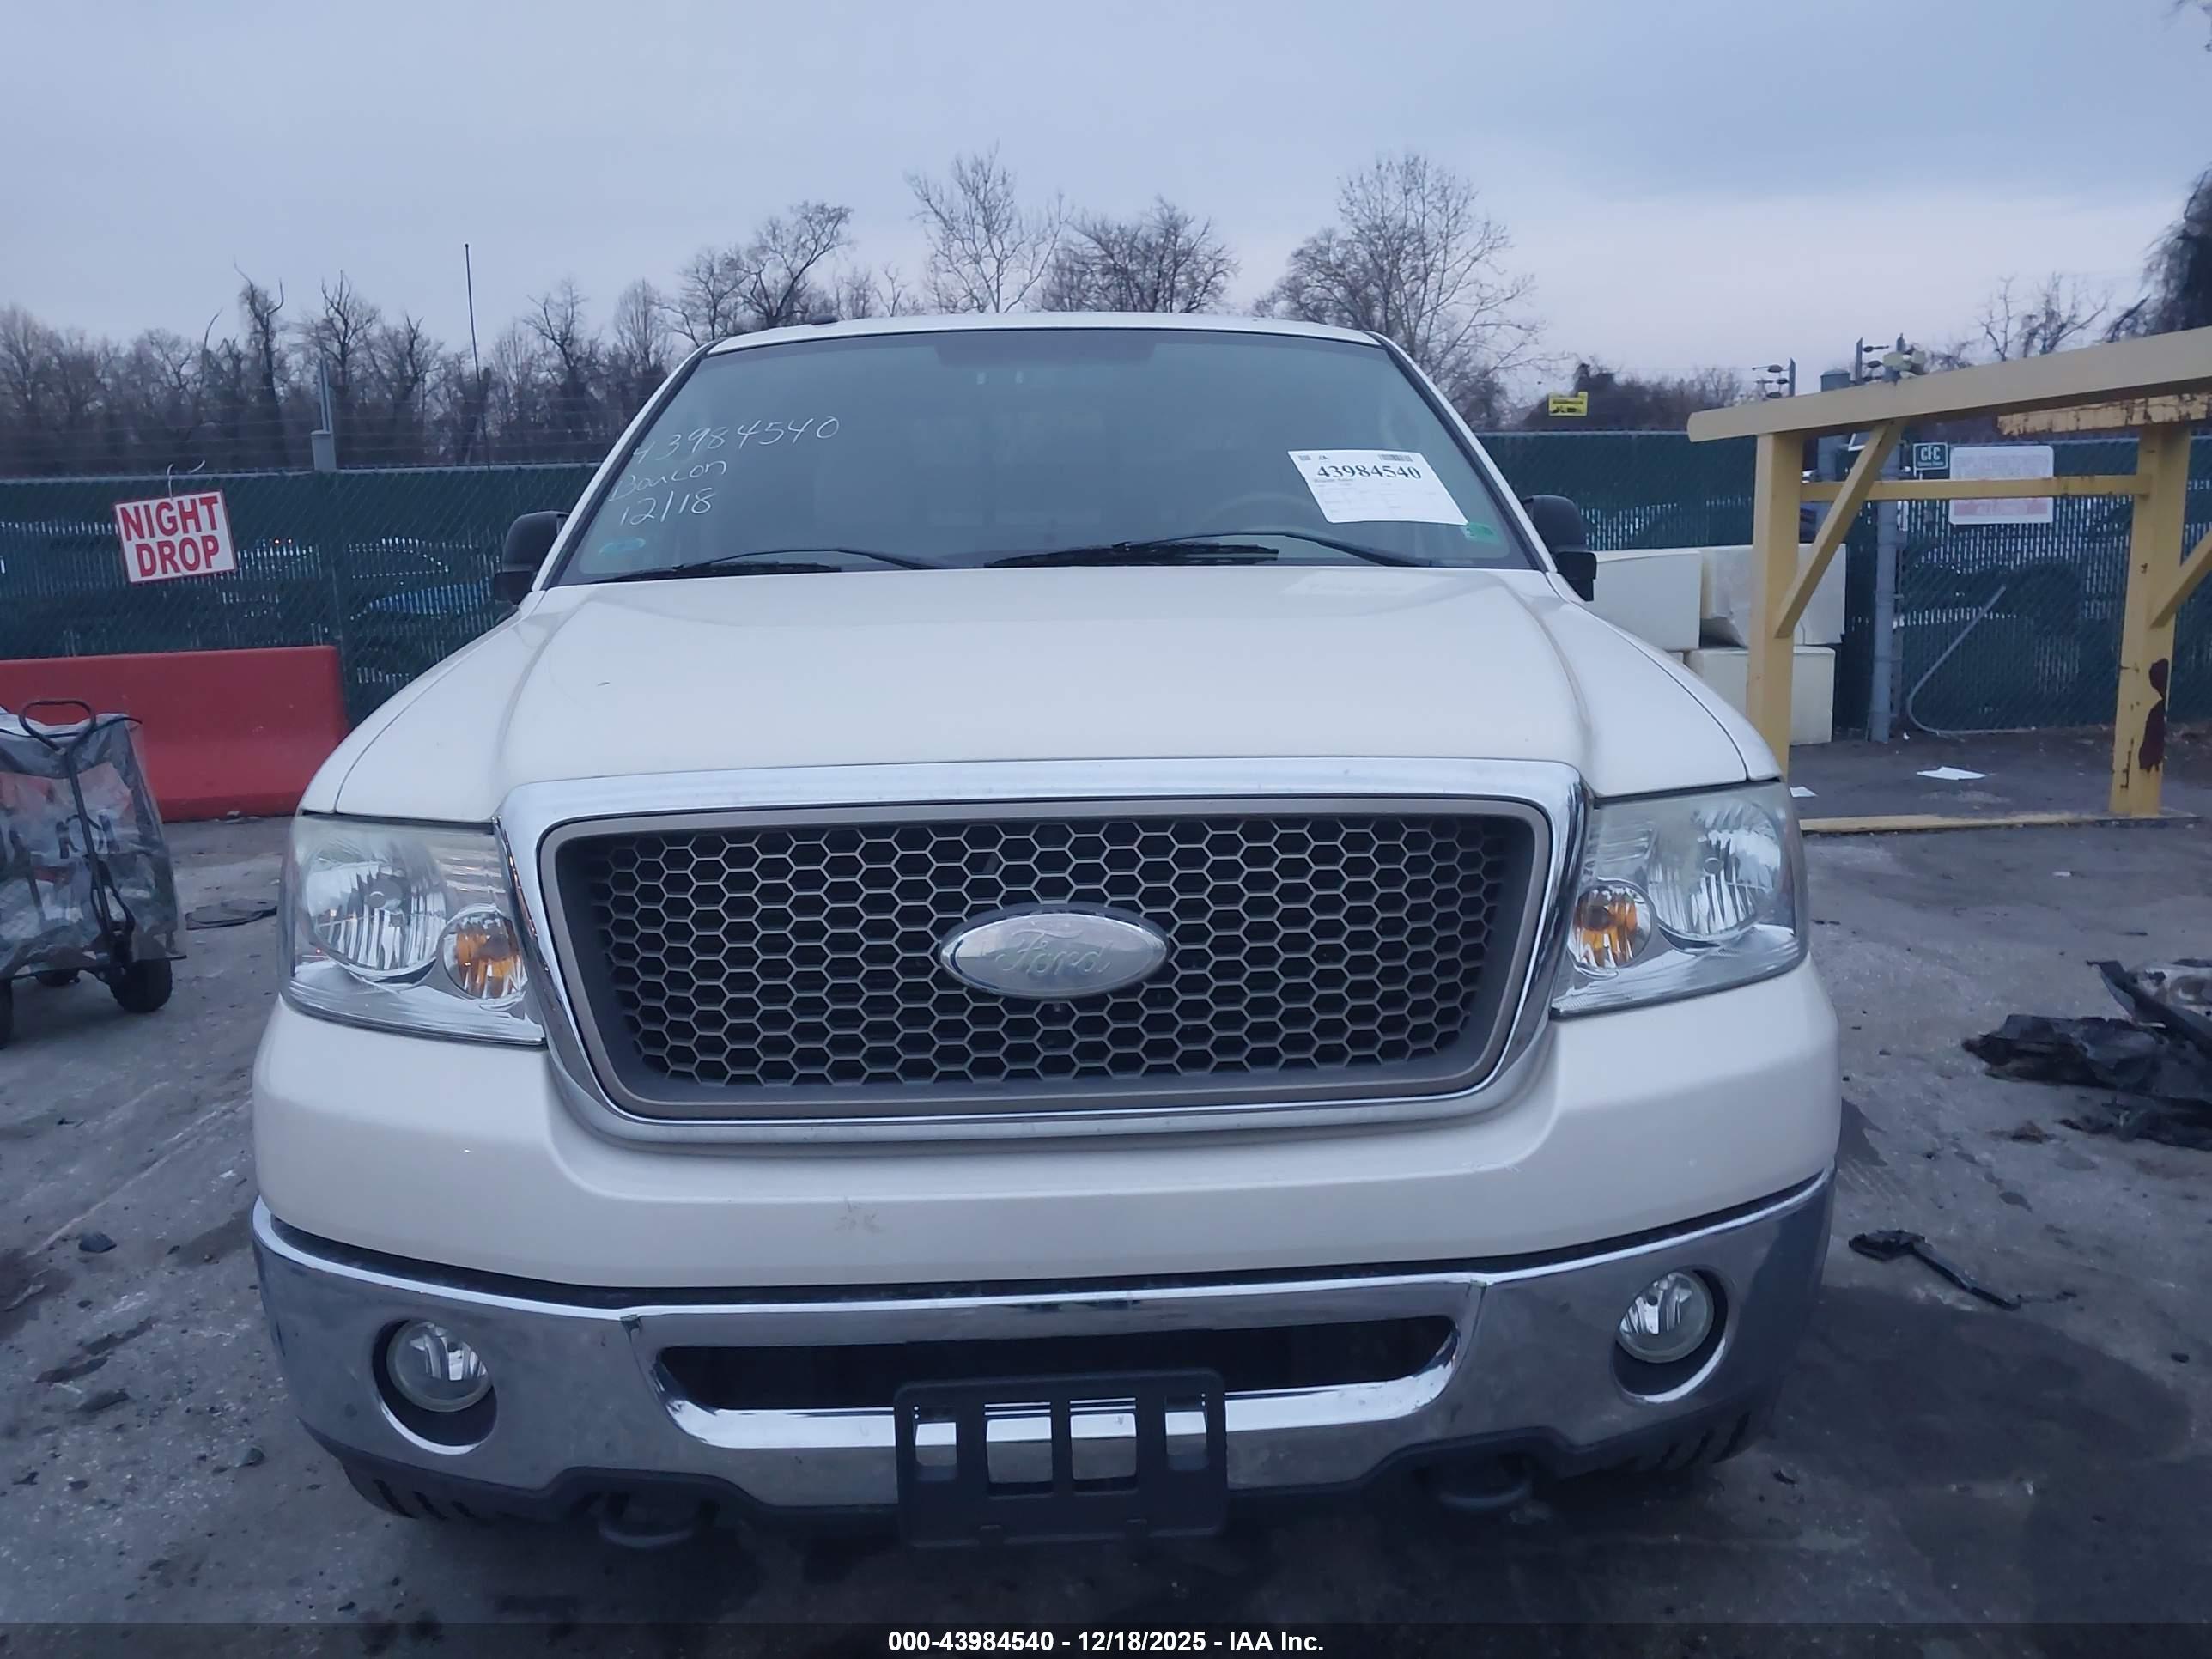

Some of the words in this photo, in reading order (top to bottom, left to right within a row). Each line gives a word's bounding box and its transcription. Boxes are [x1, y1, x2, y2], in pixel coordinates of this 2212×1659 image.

[633, 416, 841, 464] 43984540
[1920, 446, 1941, 461] CFC
[1316, 465, 1422, 479] 43984540
[120, 496, 219, 542] NIGHT
[620, 487, 716, 526] 12/18
[135, 535, 220, 578] DROP
[995, 929, 1111, 976] Ford
